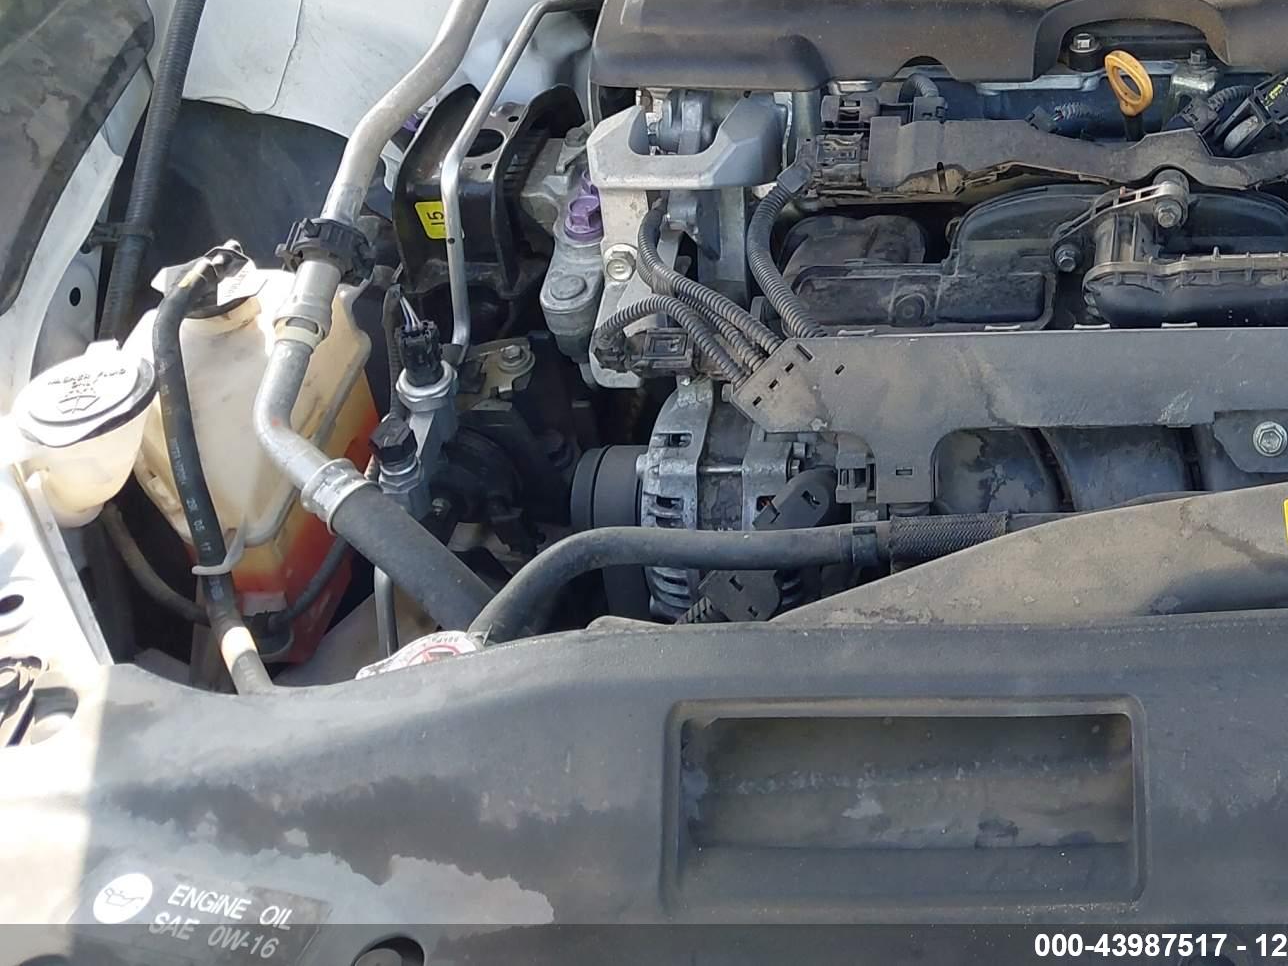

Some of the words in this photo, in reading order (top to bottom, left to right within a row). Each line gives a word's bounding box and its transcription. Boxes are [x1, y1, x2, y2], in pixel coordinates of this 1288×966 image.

[167, 884, 252, 920] ENGINE
[259, 905, 293, 931] OIL
[149, 911, 201, 941] SAE
[207, 925, 280, 959] 0W-16
